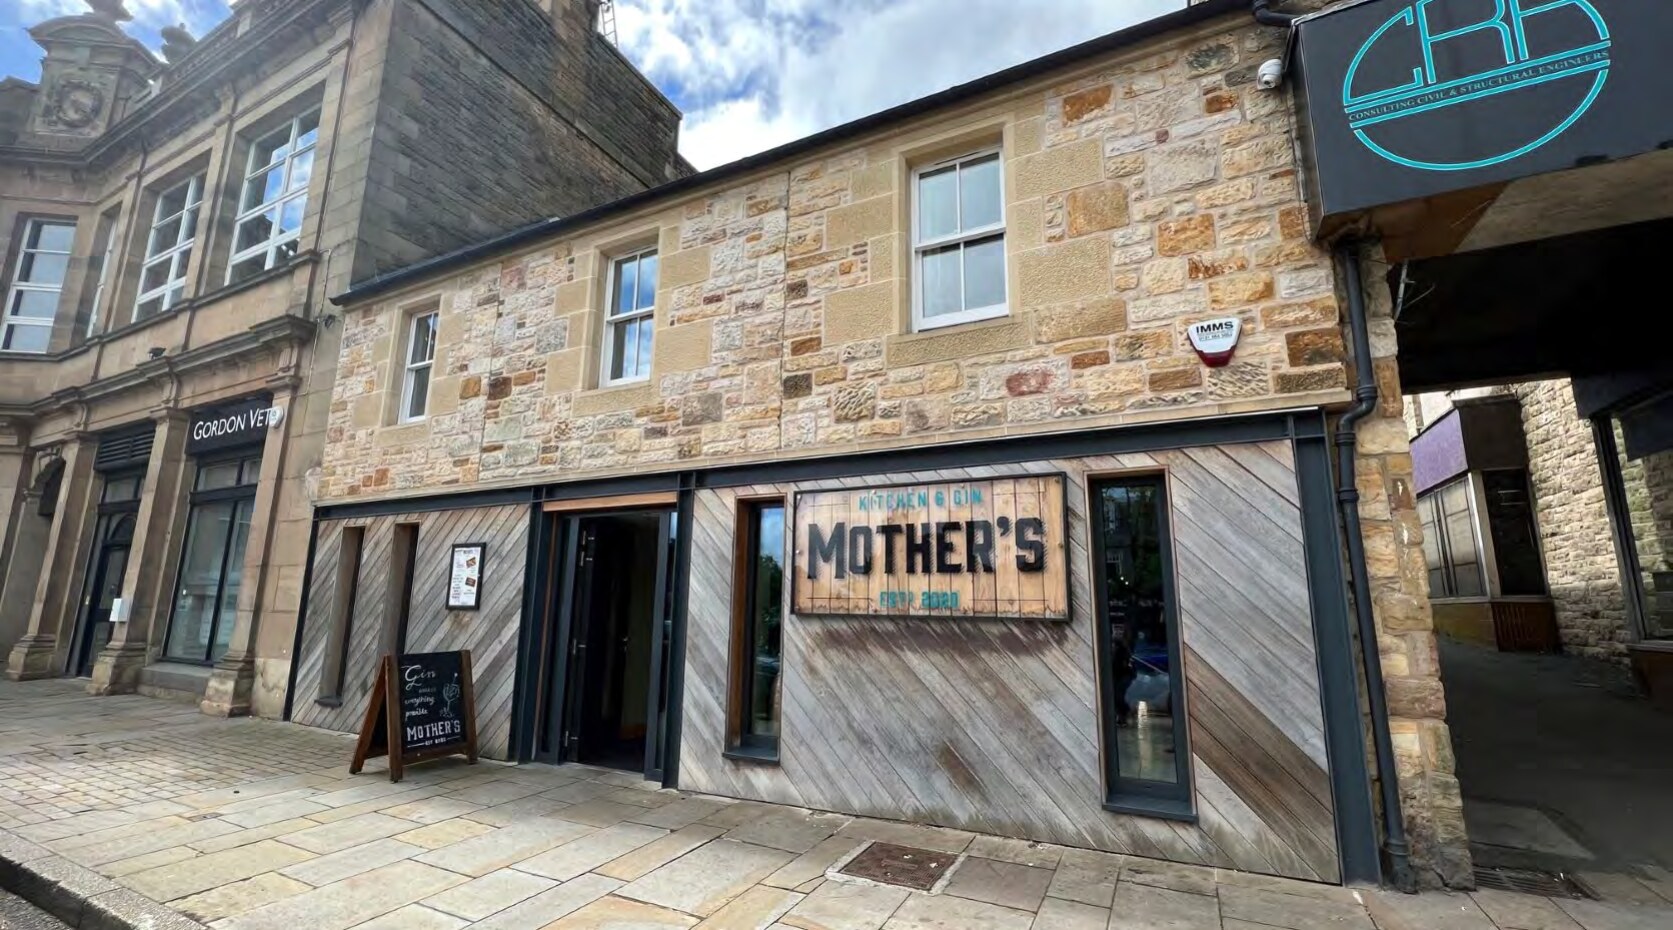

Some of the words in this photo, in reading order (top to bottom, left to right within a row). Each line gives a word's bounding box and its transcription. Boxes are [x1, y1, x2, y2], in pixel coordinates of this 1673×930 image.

[1348, 100, 1416, 121] CONSULTING
[1416, 90, 1447, 105] CIVIL
[1449, 87, 1458, 97] &
[1459, 70, 1537, 94] STRUCTURAL
[1538, 50, 1609, 74] ENGINEERS
[1196, 321, 1234, 334] IMMS
[193, 414, 247, 441] GORDON
[249, 408, 272, 429] VET
[858, 490, 928, 511] KITCHEN
[953, 488, 983, 506] GIN
[807, 516, 1047, 580] MOTHER'S
[401, 664, 436, 691] Gin
[406, 720, 461, 742] MOTHER'S
